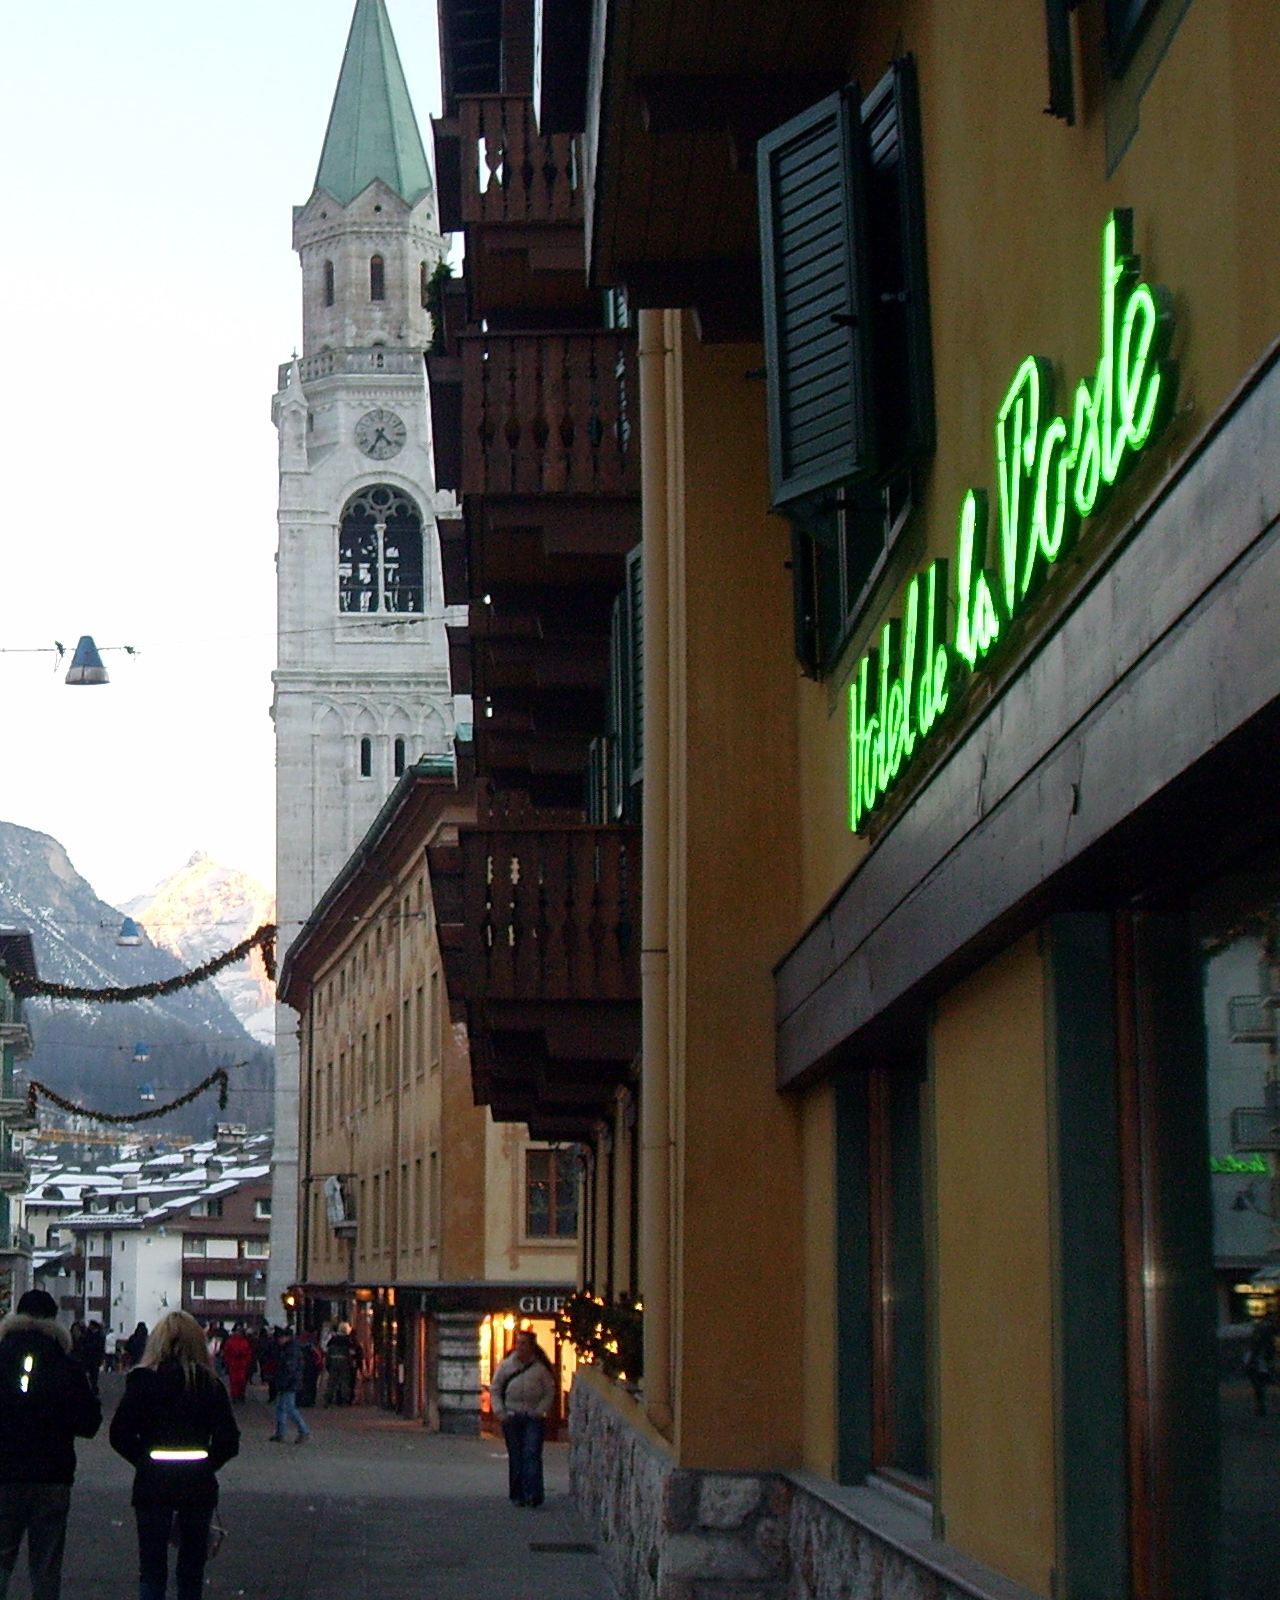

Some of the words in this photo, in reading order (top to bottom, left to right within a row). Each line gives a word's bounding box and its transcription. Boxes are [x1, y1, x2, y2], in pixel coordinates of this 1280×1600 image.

[849, 574, 921, 834] Hotel
[918, 560, 950, 736] de
[956, 487, 1001, 669] la
[996, 208, 1163, 621] Poste
